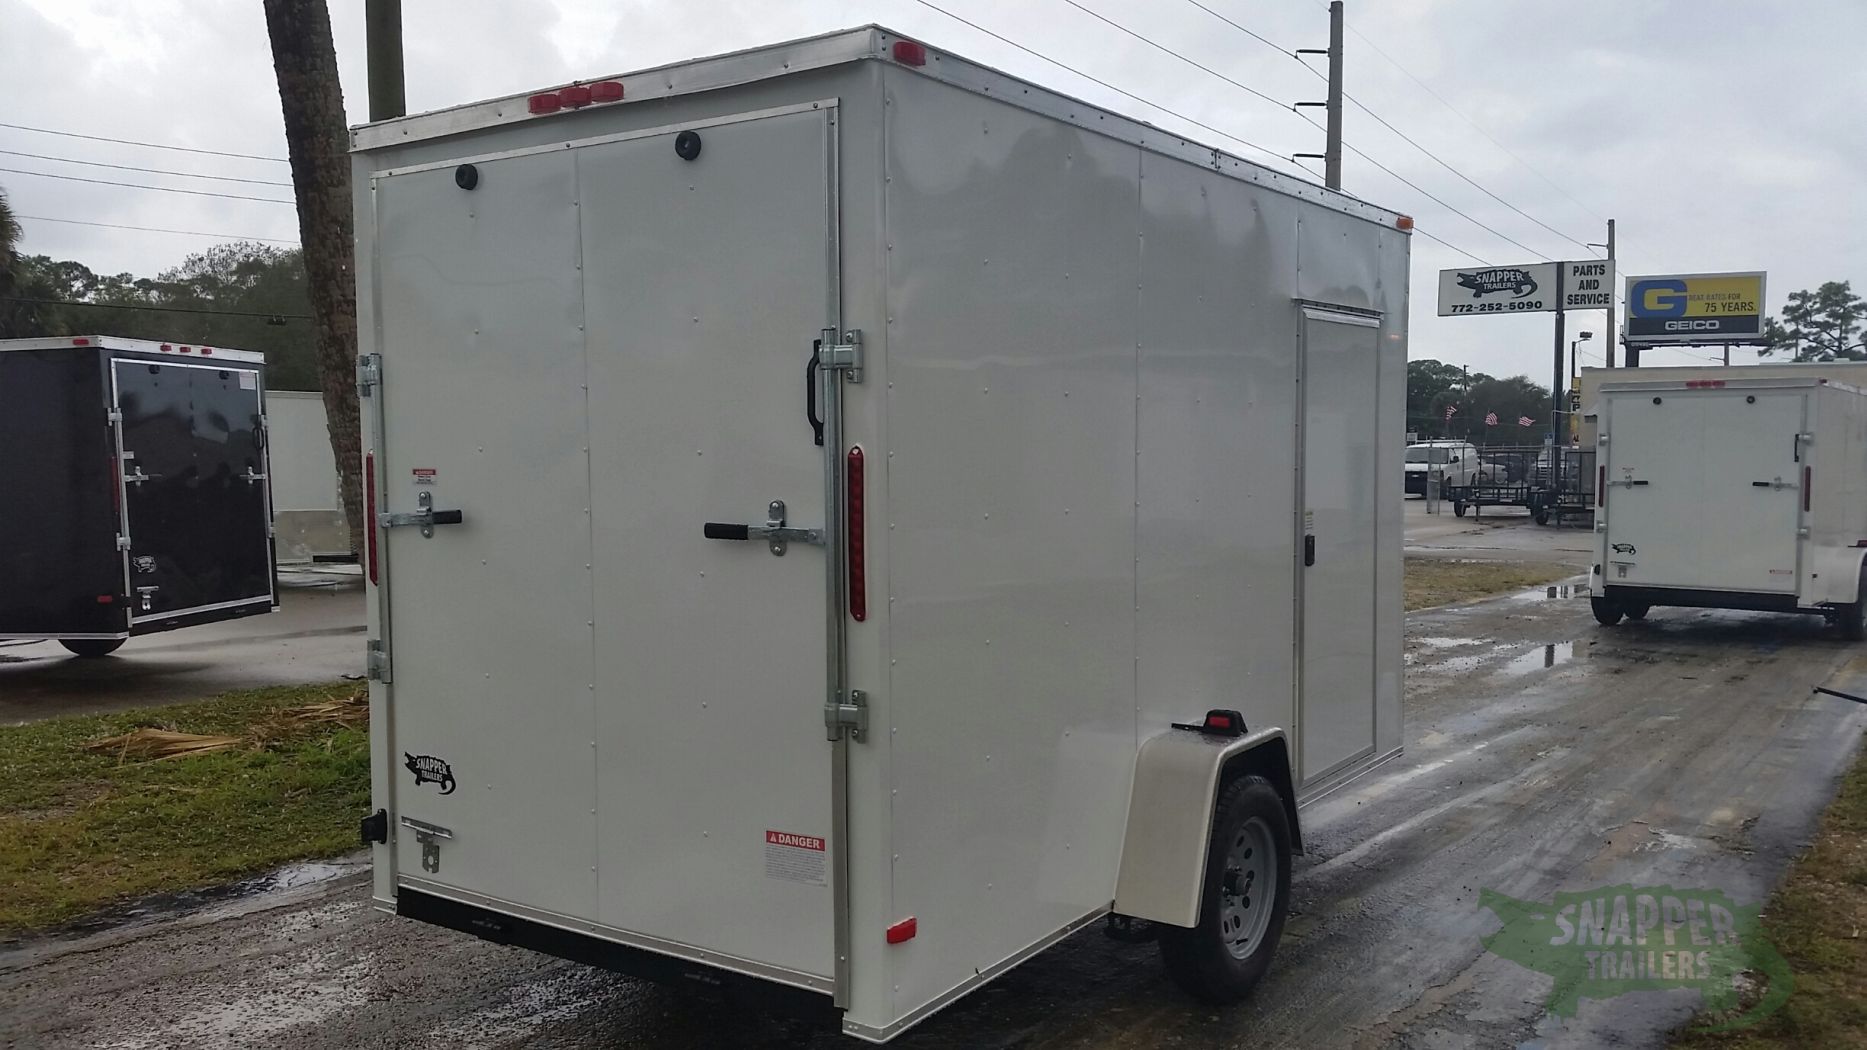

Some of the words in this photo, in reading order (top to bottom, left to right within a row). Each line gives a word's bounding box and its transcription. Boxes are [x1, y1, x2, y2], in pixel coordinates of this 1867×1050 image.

[1573, 264, 1605, 276] PARTS
[1475, 271, 1524, 284] SNAPPER
[1483, 282, 1516, 290] TRAILERS
[1578, 279, 1599, 290] AND
[1567, 293, 1610, 305] SERVICE
[1451, 301, 1542, 312] 772-252-5090
[1704, 302, 1717, 312] 75
[1721, 301, 1756, 312] YEARS.
[1665, 320, 1720, 330] GEICO
[415, 758, 447, 775] SNAPPER
[421, 770, 443, 781] TRAILERS
[778, 834, 820, 849] DANGER
